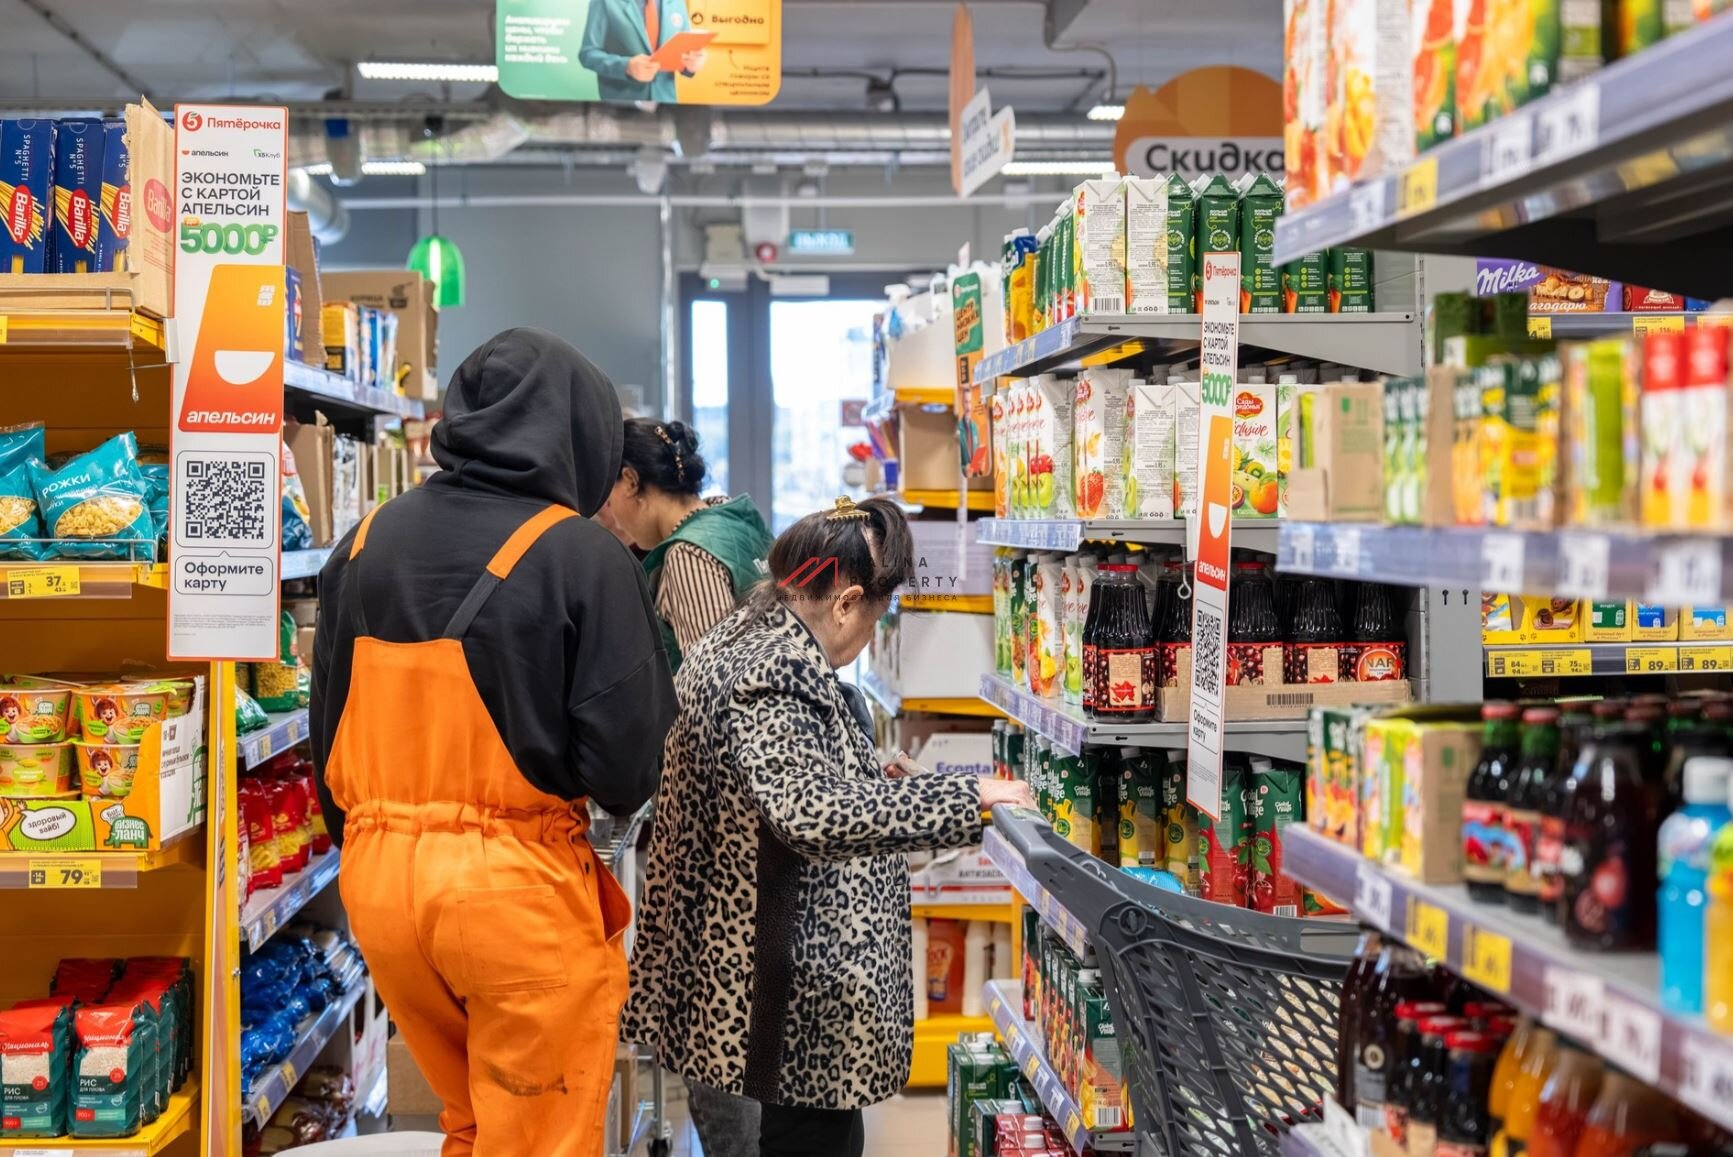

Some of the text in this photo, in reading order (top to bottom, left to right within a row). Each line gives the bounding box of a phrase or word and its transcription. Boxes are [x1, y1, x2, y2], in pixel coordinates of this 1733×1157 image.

[712, 15, 764, 25] Выгодно
[207, 117, 281, 131] Пятёрочка
[21, 134, 31, 181] SPAGHETTI
[1145, 142, 1284, 172] Скидка
[181, 172, 280, 186] ЭКОНОМЬТЕ
[181, 187, 261, 201] С КАРТОЙ
[14, 195, 29, 238] Barilla
[117, 192, 131, 232] Barilla
[181, 203, 269, 216] АПЕЛЬСИН
[73, 198, 87, 242] Barilla
[180, 222, 279, 255] 5000₽
[1213, 265, 1237, 277] Пятёрочка
[1477, 262, 1540, 295] Milka
[1528, 302, 1586, 312] агодарю
[1204, 322, 1234, 336] ЭКОНОМЬТЕ
[1203, 335, 1229, 351] С КАРТОЙ
[1203, 354, 1231, 367] АПЕЛЬСИН
[186, 411, 275, 425] апельсин
[1235, 421, 1268, 437] clusive
[184, 562, 264, 577] Оформите
[1199, 561, 1226, 582] апельсин
[46, 575, 62, 587] 37
[184, 577, 227, 592] карту
[1648, 660, 1664, 671] 89
[1702, 660, 1717, 670] 89
[1193, 709, 1218, 733] Оформите
[1193, 727, 1206, 742] карту
[27, 812, 67, 828] здоровый
[39, 823, 60, 835] вайб!
[60, 869, 83, 884] 79
[2, 1042, 49, 1051] Националь
[79, 1079, 97, 1087] РИС
